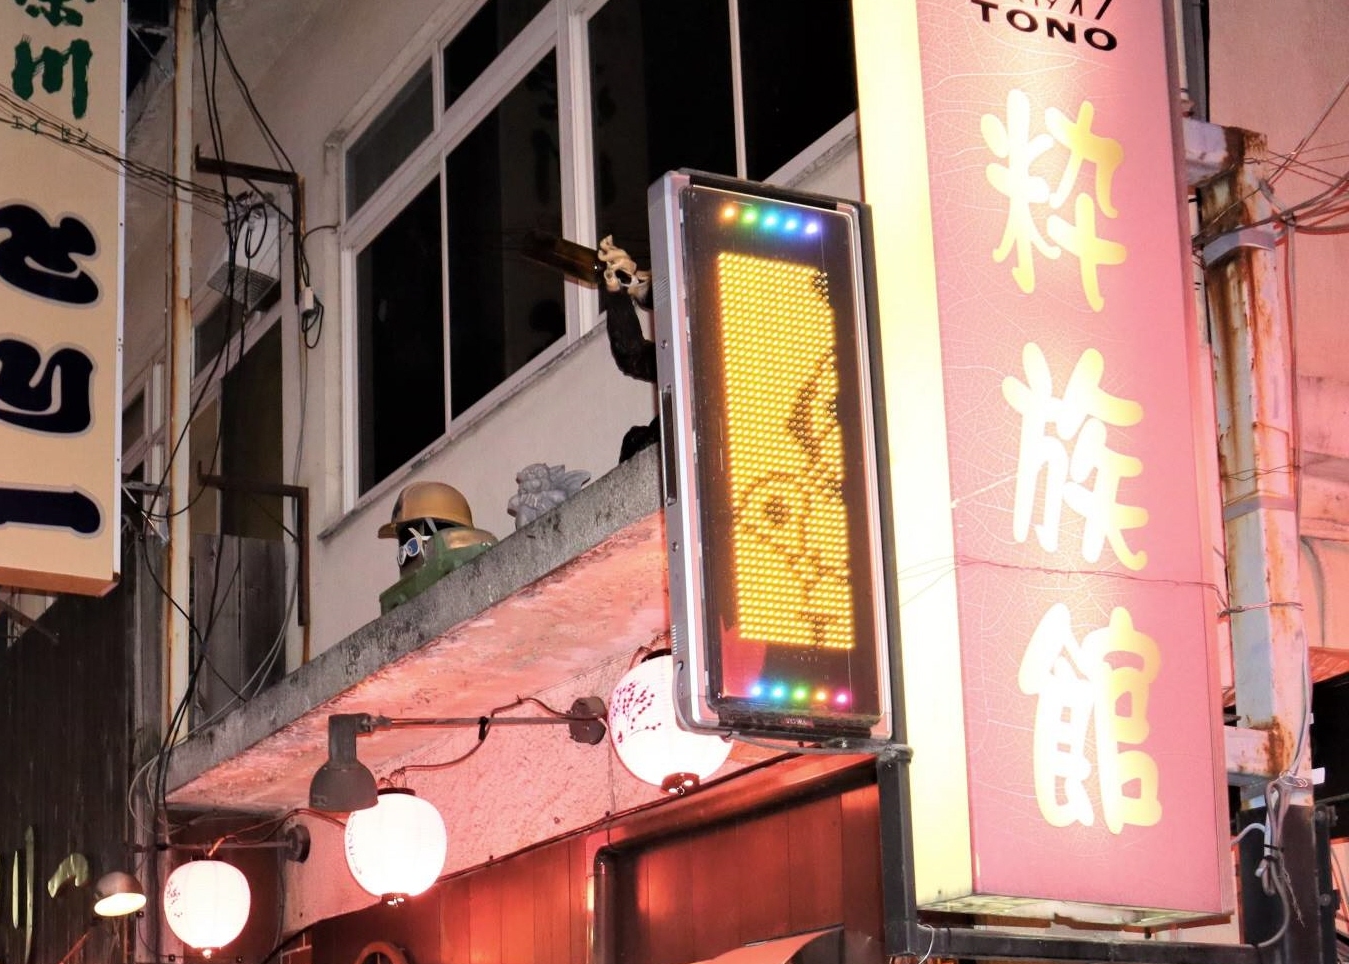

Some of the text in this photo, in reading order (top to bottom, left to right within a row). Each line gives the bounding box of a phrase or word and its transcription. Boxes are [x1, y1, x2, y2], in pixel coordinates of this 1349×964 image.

[970, 0, 1118, 51] TONO
[979, 87, 1162, 836] 粋族館
